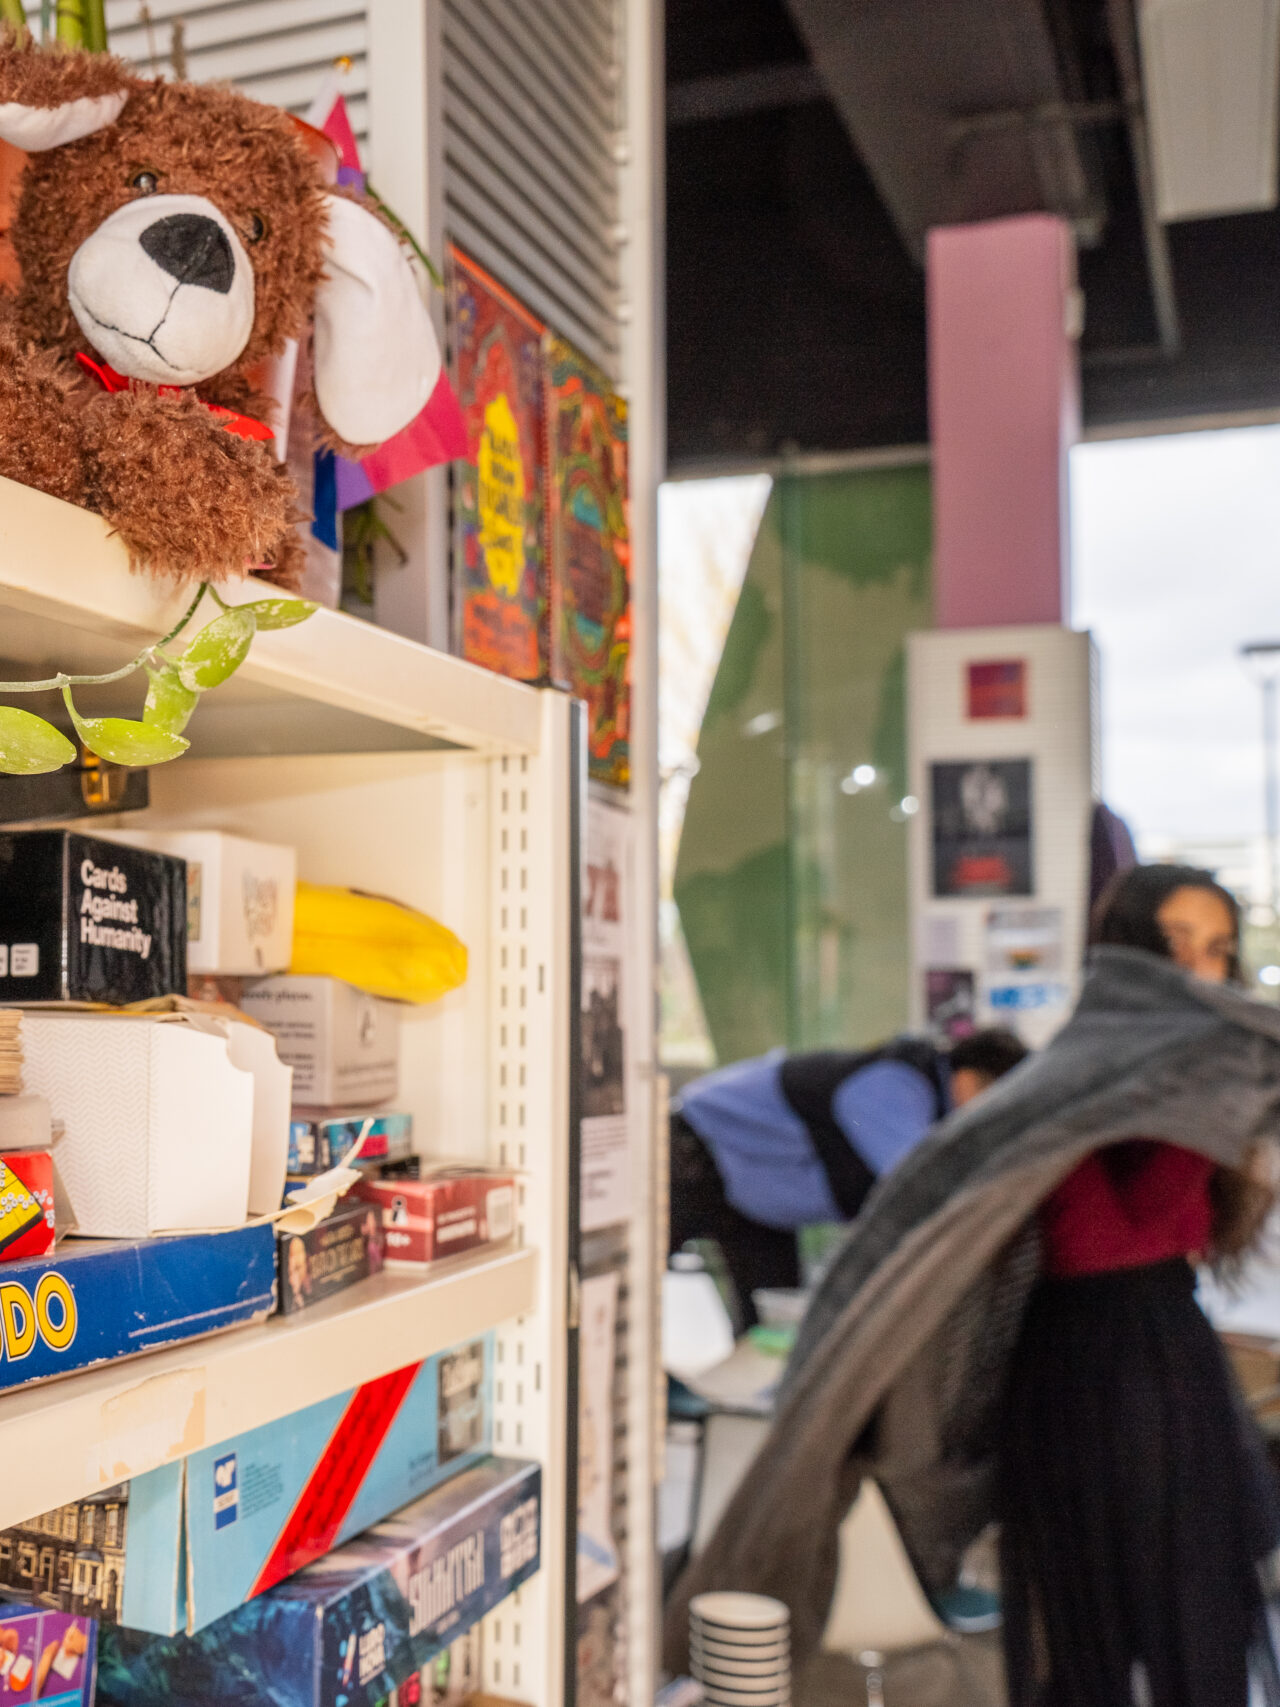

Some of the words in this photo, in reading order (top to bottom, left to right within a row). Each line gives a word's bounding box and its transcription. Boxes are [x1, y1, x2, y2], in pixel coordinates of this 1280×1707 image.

[81, 859, 128, 894] Cards
[81, 887, 139, 925] Against
[80, 916, 152, 959] Humanity
